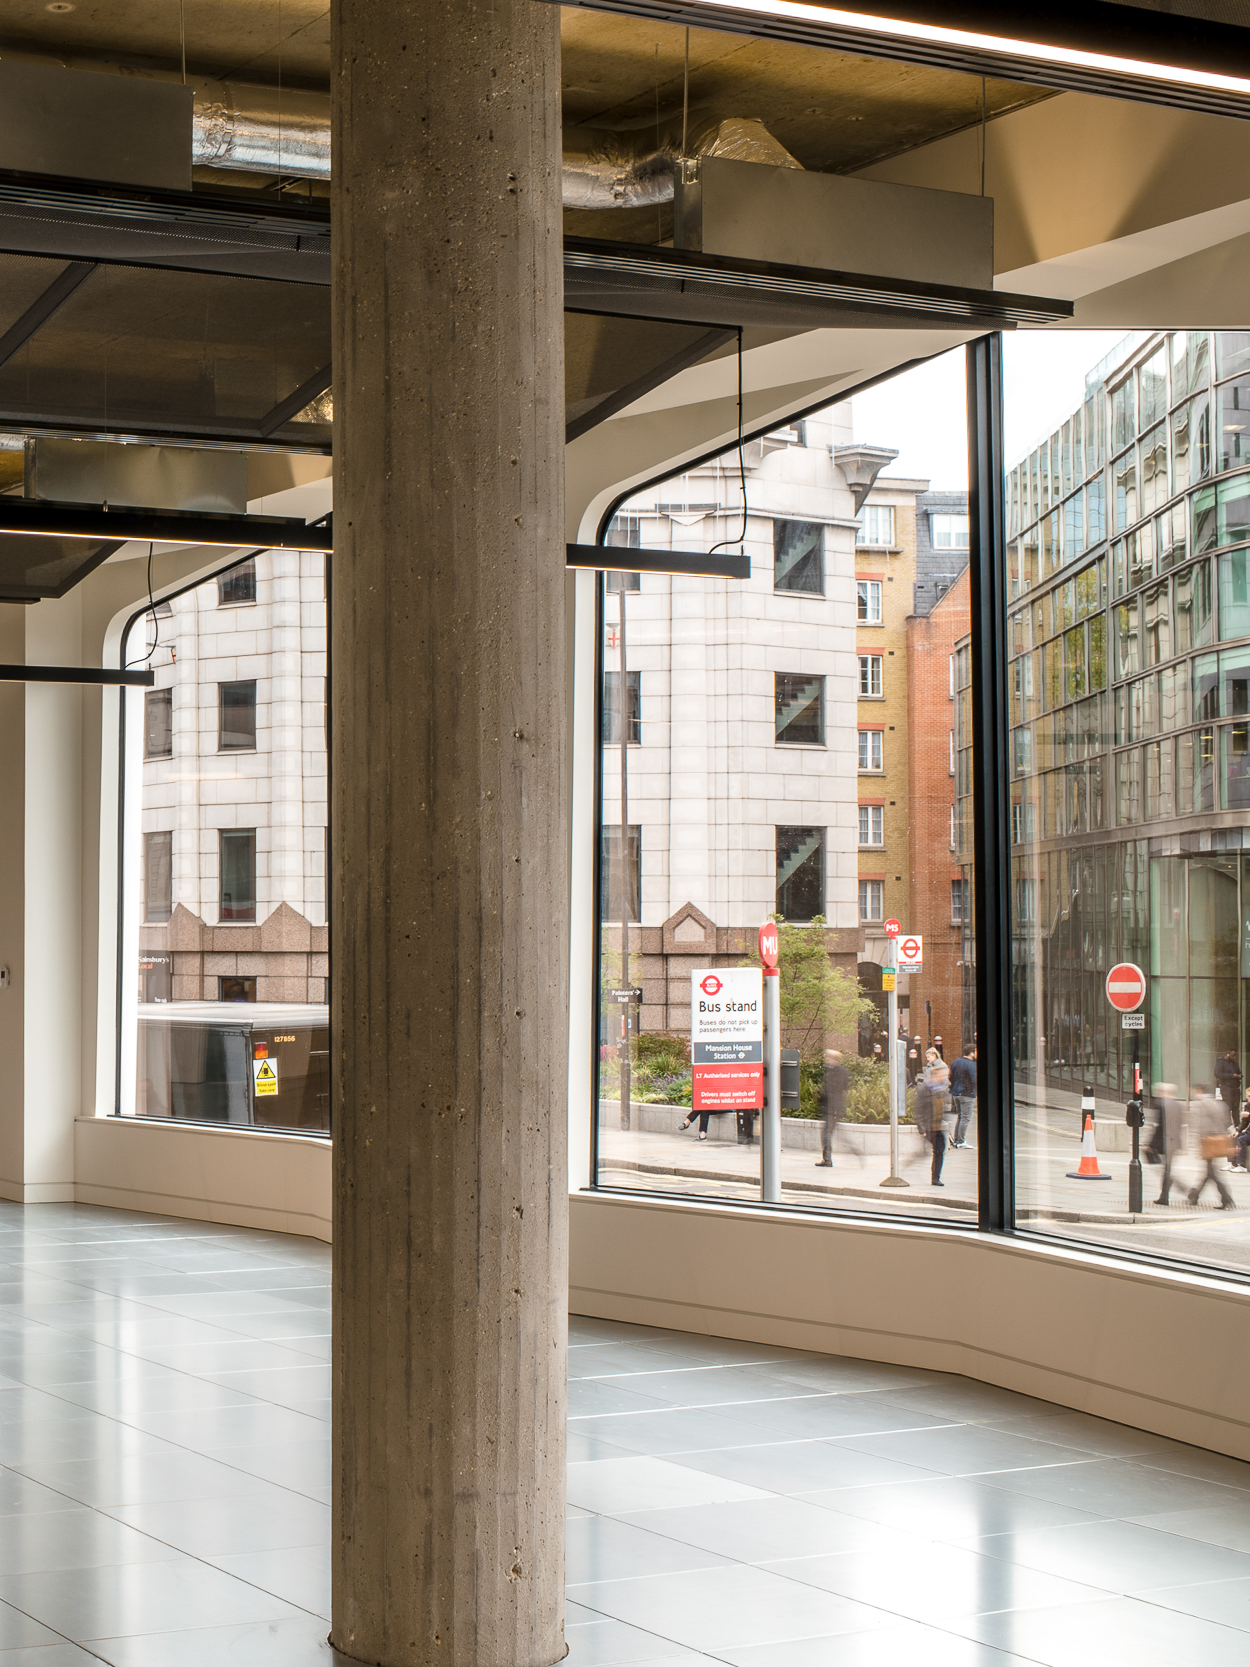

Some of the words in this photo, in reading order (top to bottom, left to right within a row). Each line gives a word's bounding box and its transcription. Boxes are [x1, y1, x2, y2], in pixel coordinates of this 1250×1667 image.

[886, 924, 899, 932] MS
[763, 936, 777, 955] MU
[139, 956, 169, 964] Sainsbury's
[699, 1001, 721, 1012] Bus
[725, 1000, 757, 1012] stand
[705, 1044, 732, 1052] Mansion
[713, 1052, 736, 1060] Station
